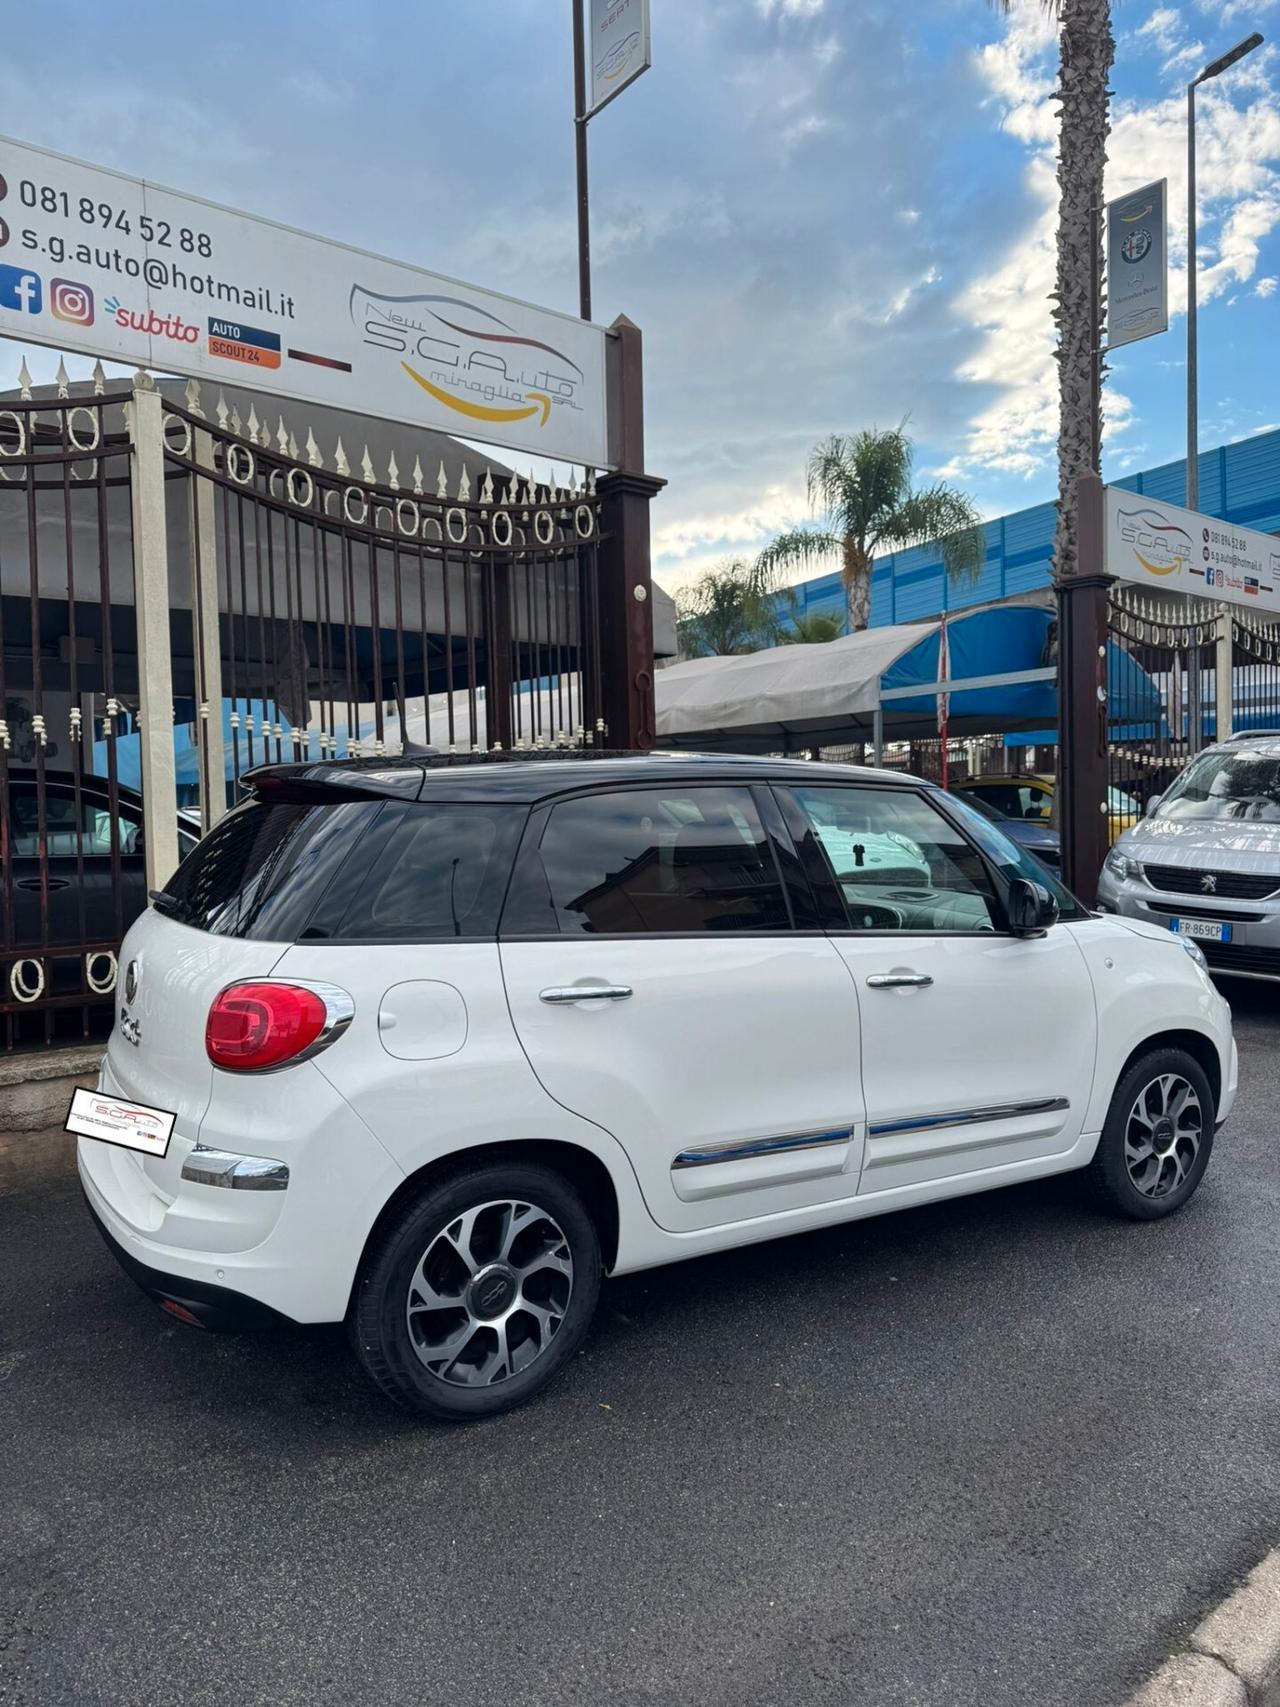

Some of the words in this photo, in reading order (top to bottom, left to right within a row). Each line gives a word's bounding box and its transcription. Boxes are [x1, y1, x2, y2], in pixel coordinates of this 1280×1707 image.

[19, 180, 69, 217] 081
[79, 198, 131, 236] 894
[139, 215, 172, 247] 52
[179, 228, 213, 258] 88
[21, 229, 295, 320] s.g.auto@hotmail.it
[115, 307, 200, 344] subito
[212, 321, 241, 339] AUTO
[364, 302, 427, 333] New
[212, 341, 246, 359] SCOUT
[247, 349, 260, 362] 24
[430, 370, 526, 402] miraglia
